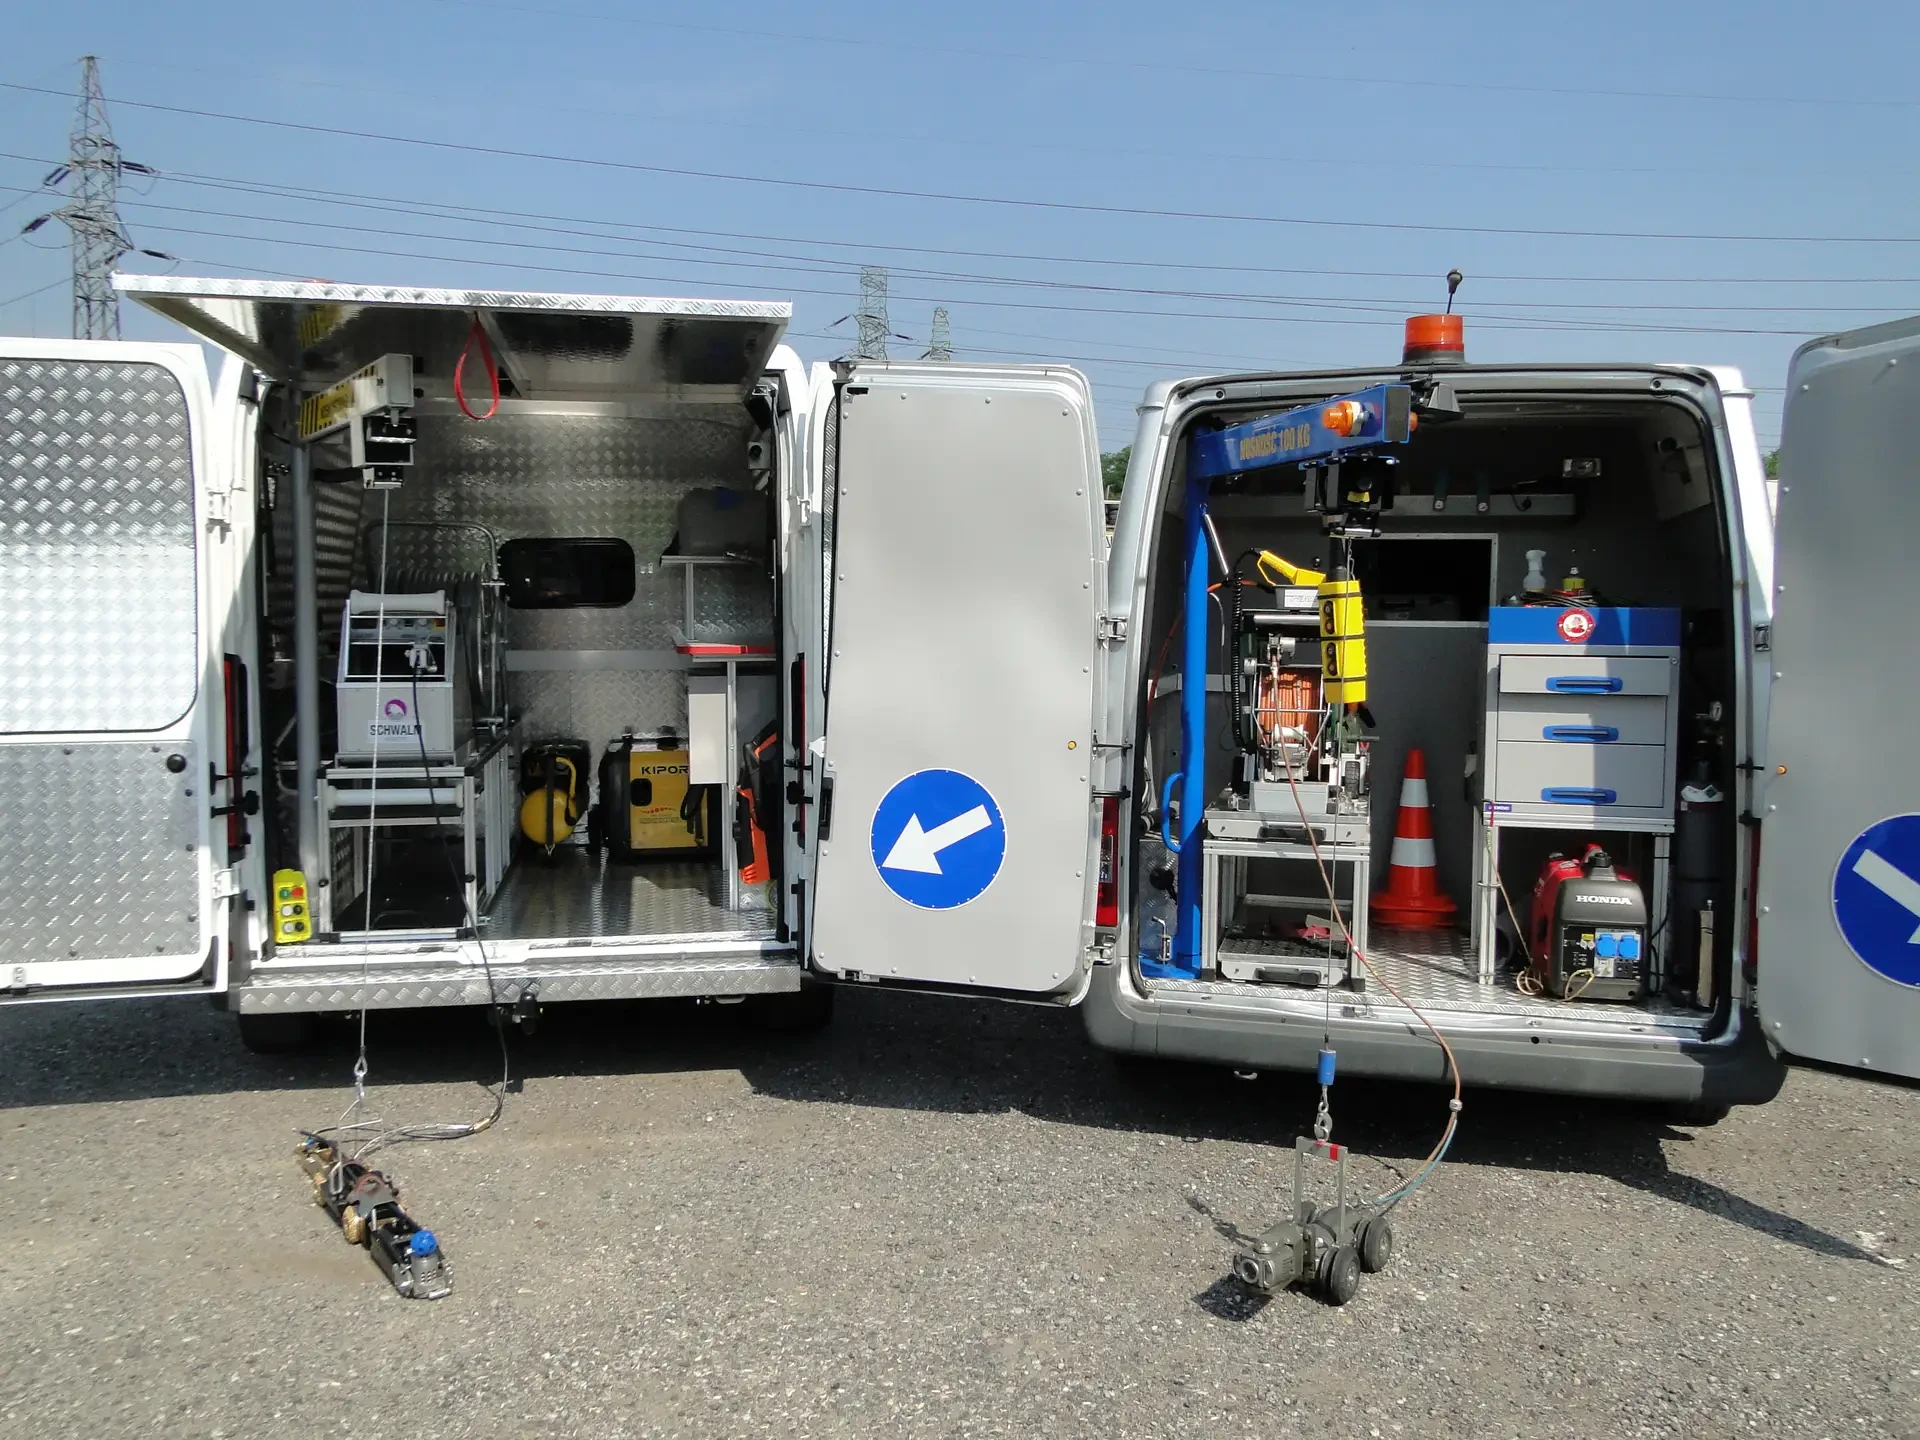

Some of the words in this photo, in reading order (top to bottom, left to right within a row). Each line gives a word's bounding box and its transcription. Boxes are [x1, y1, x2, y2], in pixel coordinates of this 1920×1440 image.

[1279, 427, 1295, 451] 100
[1297, 423, 1310, 448] KG
[641, 765, 690, 775] KIPOR
[1575, 895, 1633, 905] HONDA
